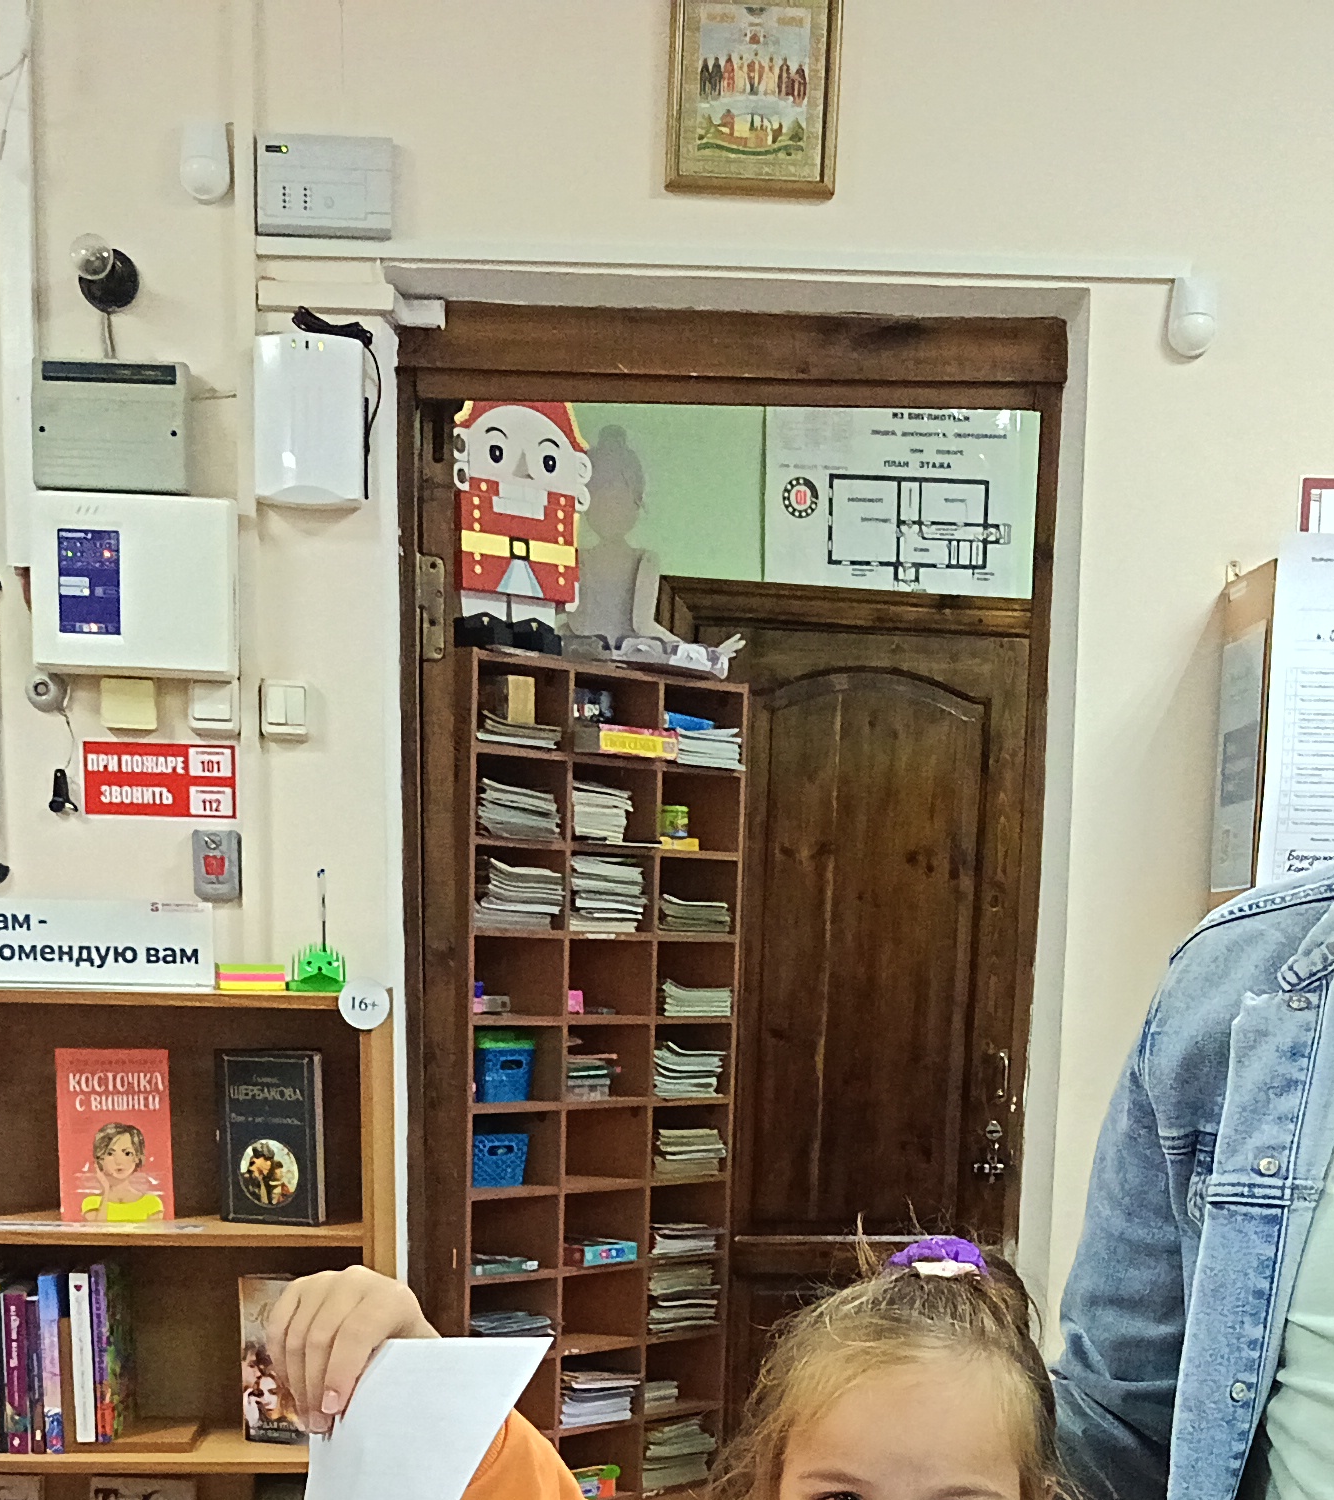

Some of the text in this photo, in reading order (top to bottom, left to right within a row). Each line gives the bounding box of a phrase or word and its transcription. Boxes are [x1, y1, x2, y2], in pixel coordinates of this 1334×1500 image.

[883, 459, 952, 470] ПЛАН ЭТАЖА
[87, 753, 186, 775] ПРИ ПОЖАРЕ
[199, 759, 222, 774] 101
[99, 785, 174, 805] ЗВОНИТЬ
[201, 797, 222, 813] 112
[145, 946, 200, 965] вам
[350, 996, 379, 1012] 16+
[68, 1072, 164, 1092] КОСТОЧКА
[75, 1092, 160, 1111] С ВИШНЕЙ
[229, 1085, 303, 1101] ЩЕРБАКОВА
